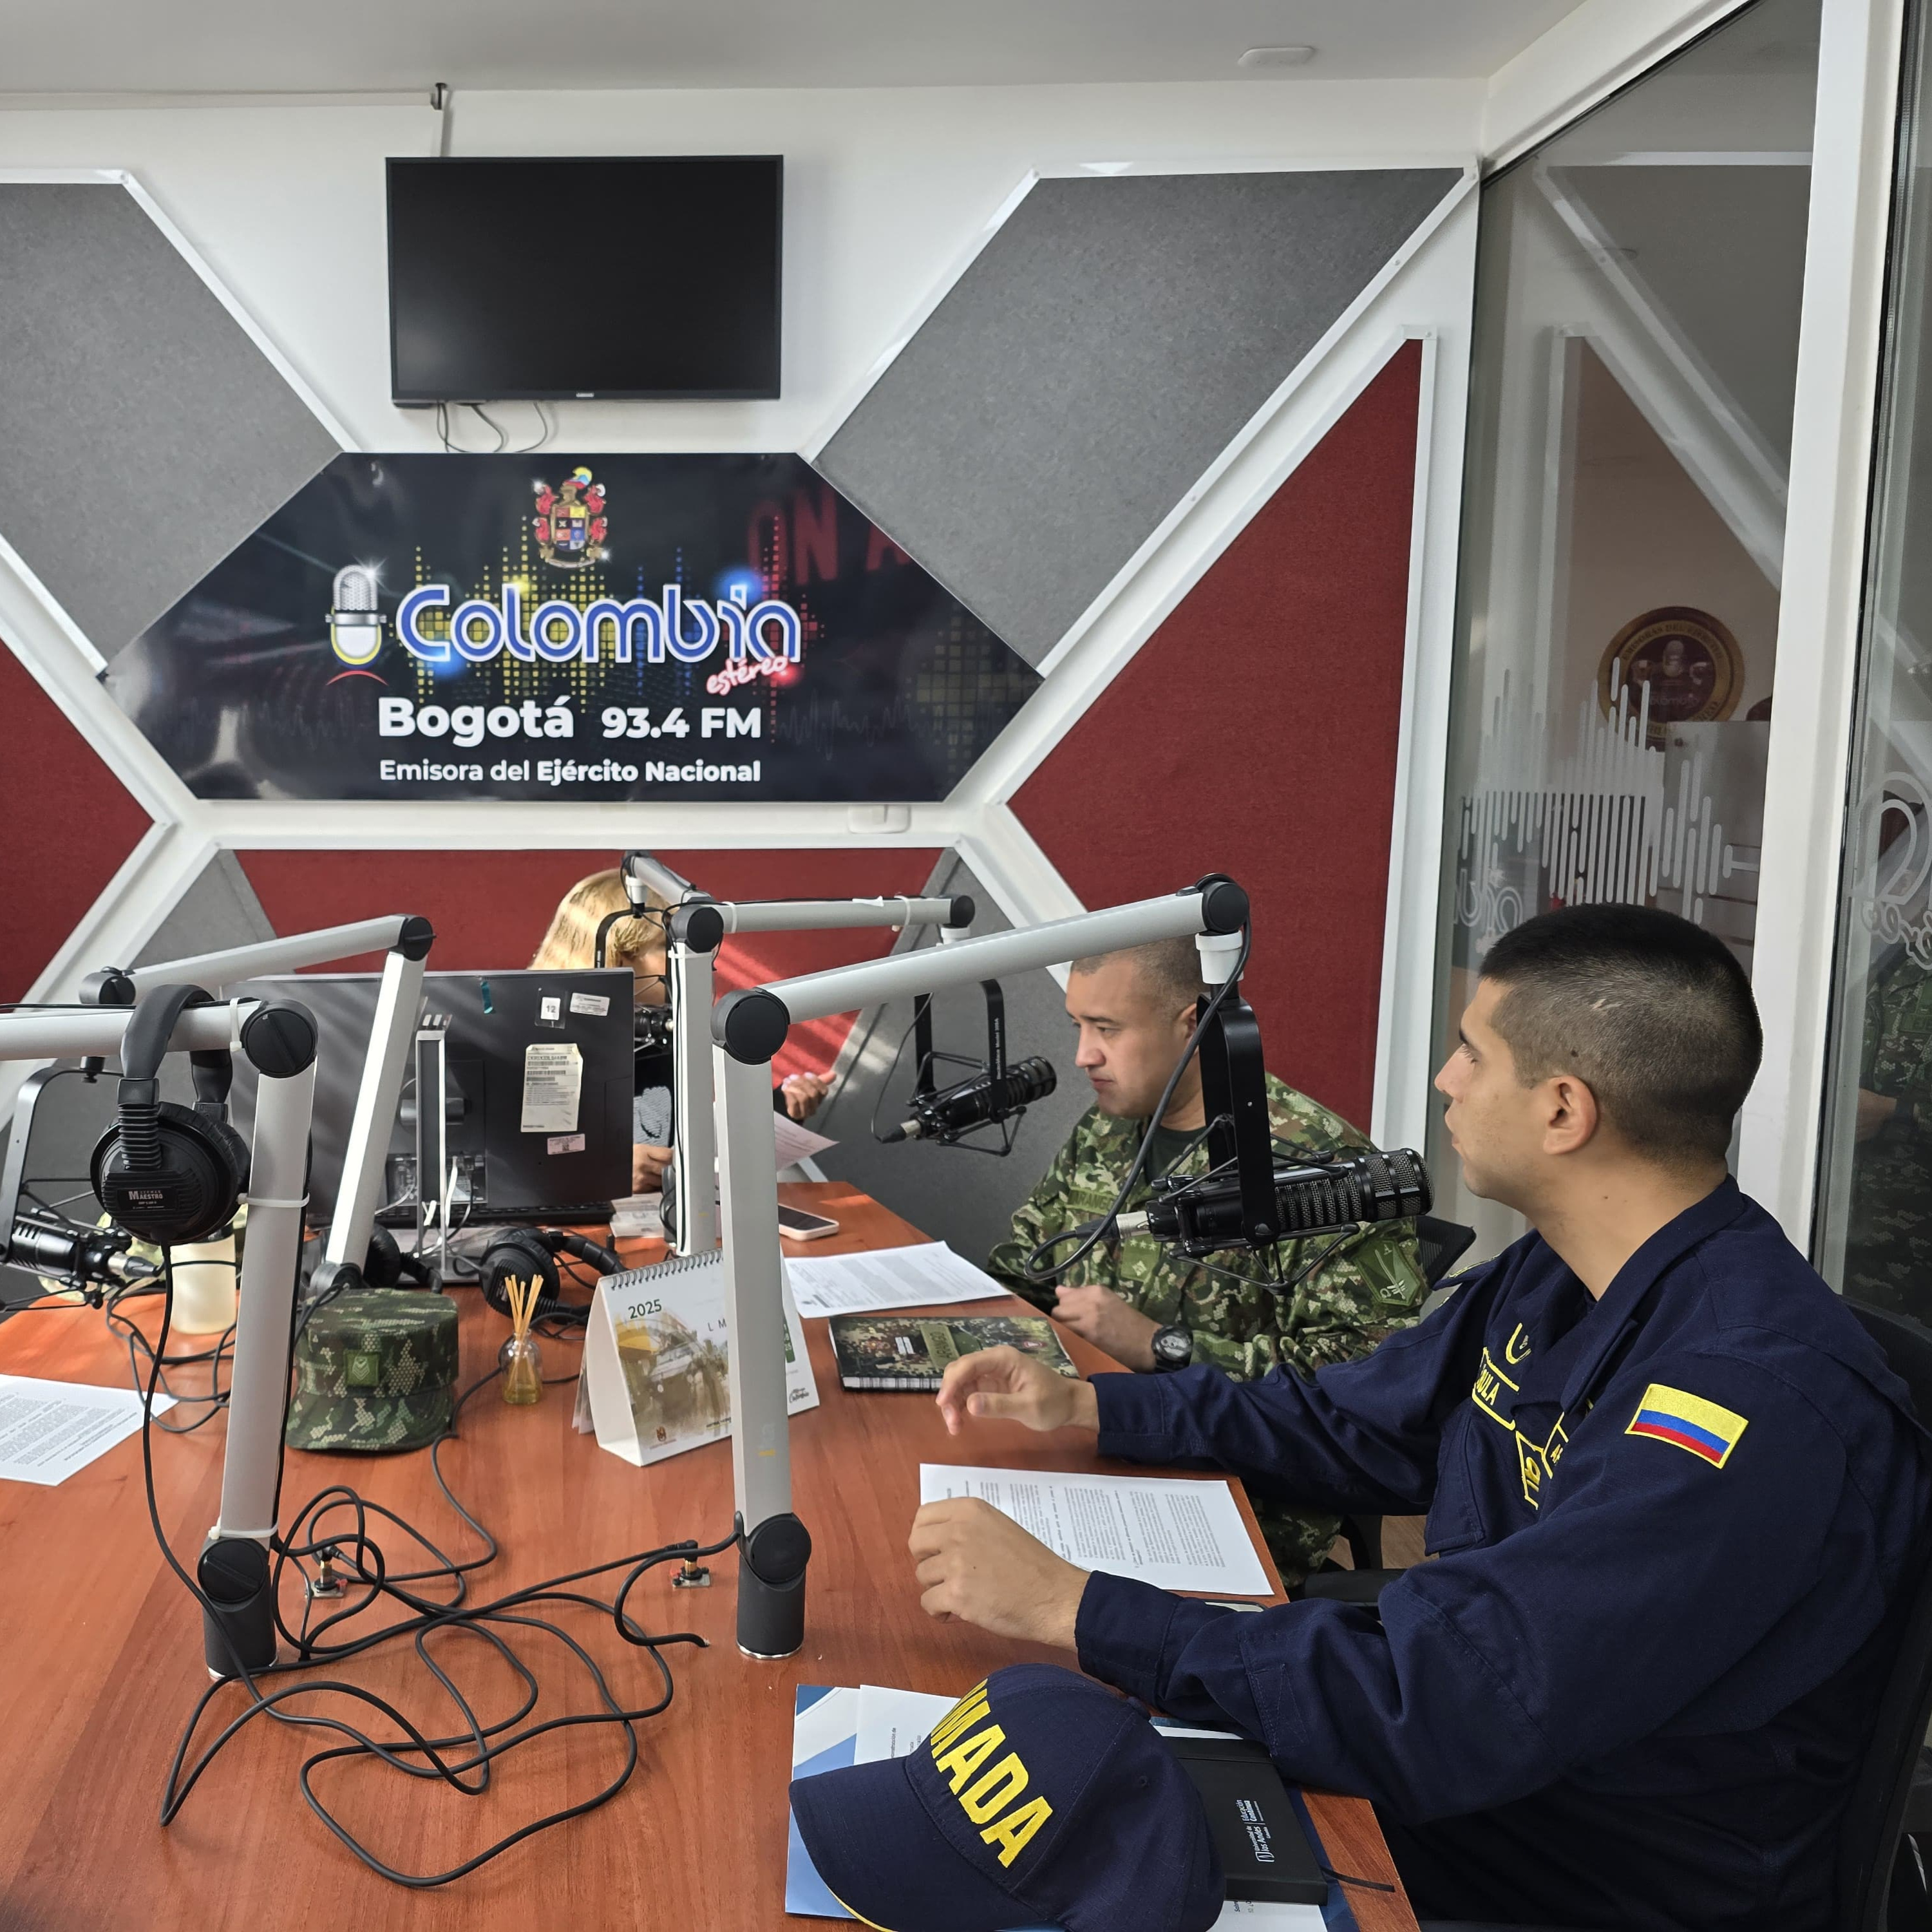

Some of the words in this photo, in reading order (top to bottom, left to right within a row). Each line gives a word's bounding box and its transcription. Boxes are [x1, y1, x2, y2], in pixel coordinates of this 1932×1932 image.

[396, 582, 802, 663] Colombia
[378, 695, 574, 747] Bogotá
[601, 706, 690, 739] 93.4
[701, 707, 761, 739] FM
[379, 759, 483, 782] Emisora
[490, 759, 529, 782] del
[537, 758, 639, 786] Ejército
[645, 759, 761, 782] Nacional
[128, 1191, 163, 1200] MAESTRO
[628, 1298, 662, 1320] 2025
[1236, 1799, 1249, 1821] Educación
[1253, 1826, 1266, 1843] Andes
